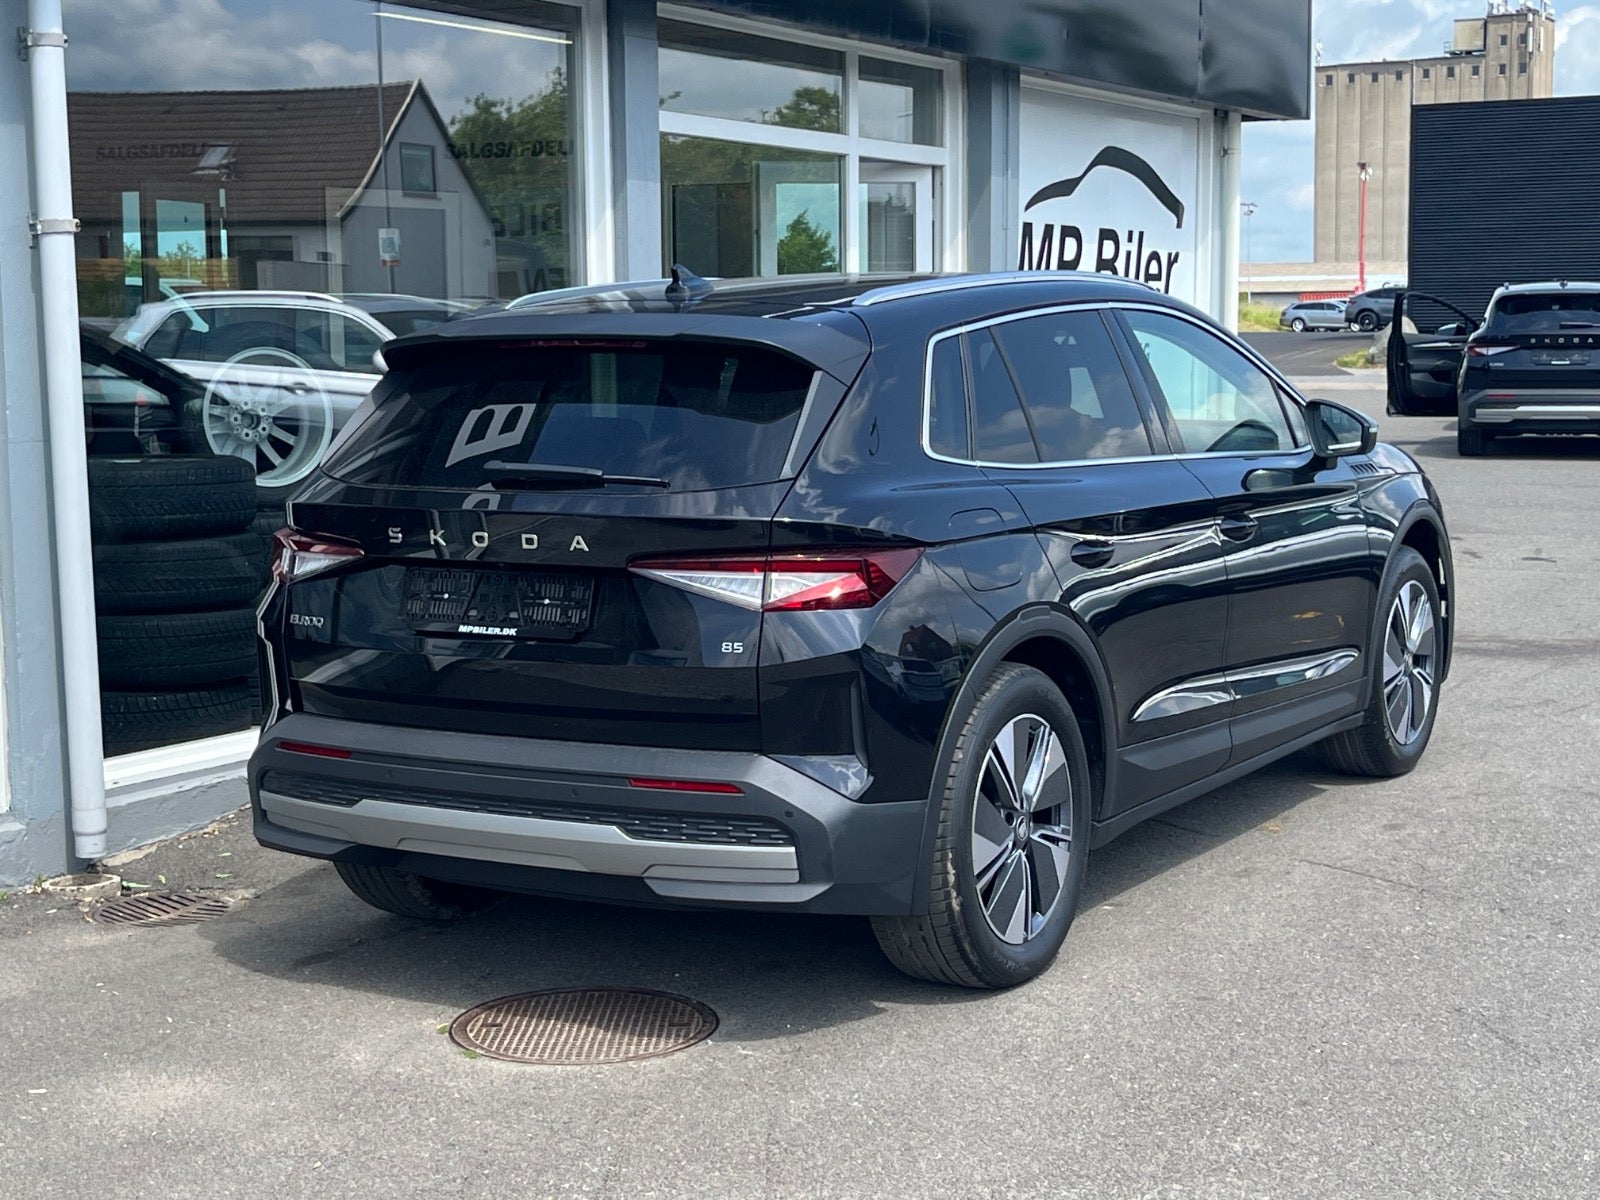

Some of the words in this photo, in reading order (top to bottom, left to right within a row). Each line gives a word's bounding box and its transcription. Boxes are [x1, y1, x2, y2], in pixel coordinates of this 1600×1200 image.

[1019, 221, 1083, 272] MP
[1095, 227, 1180, 295] Biler
[388, 527, 590, 553] SKODA
[457, 624, 518, 637] MPBILER.DK
[721, 641, 744, 653] 85
